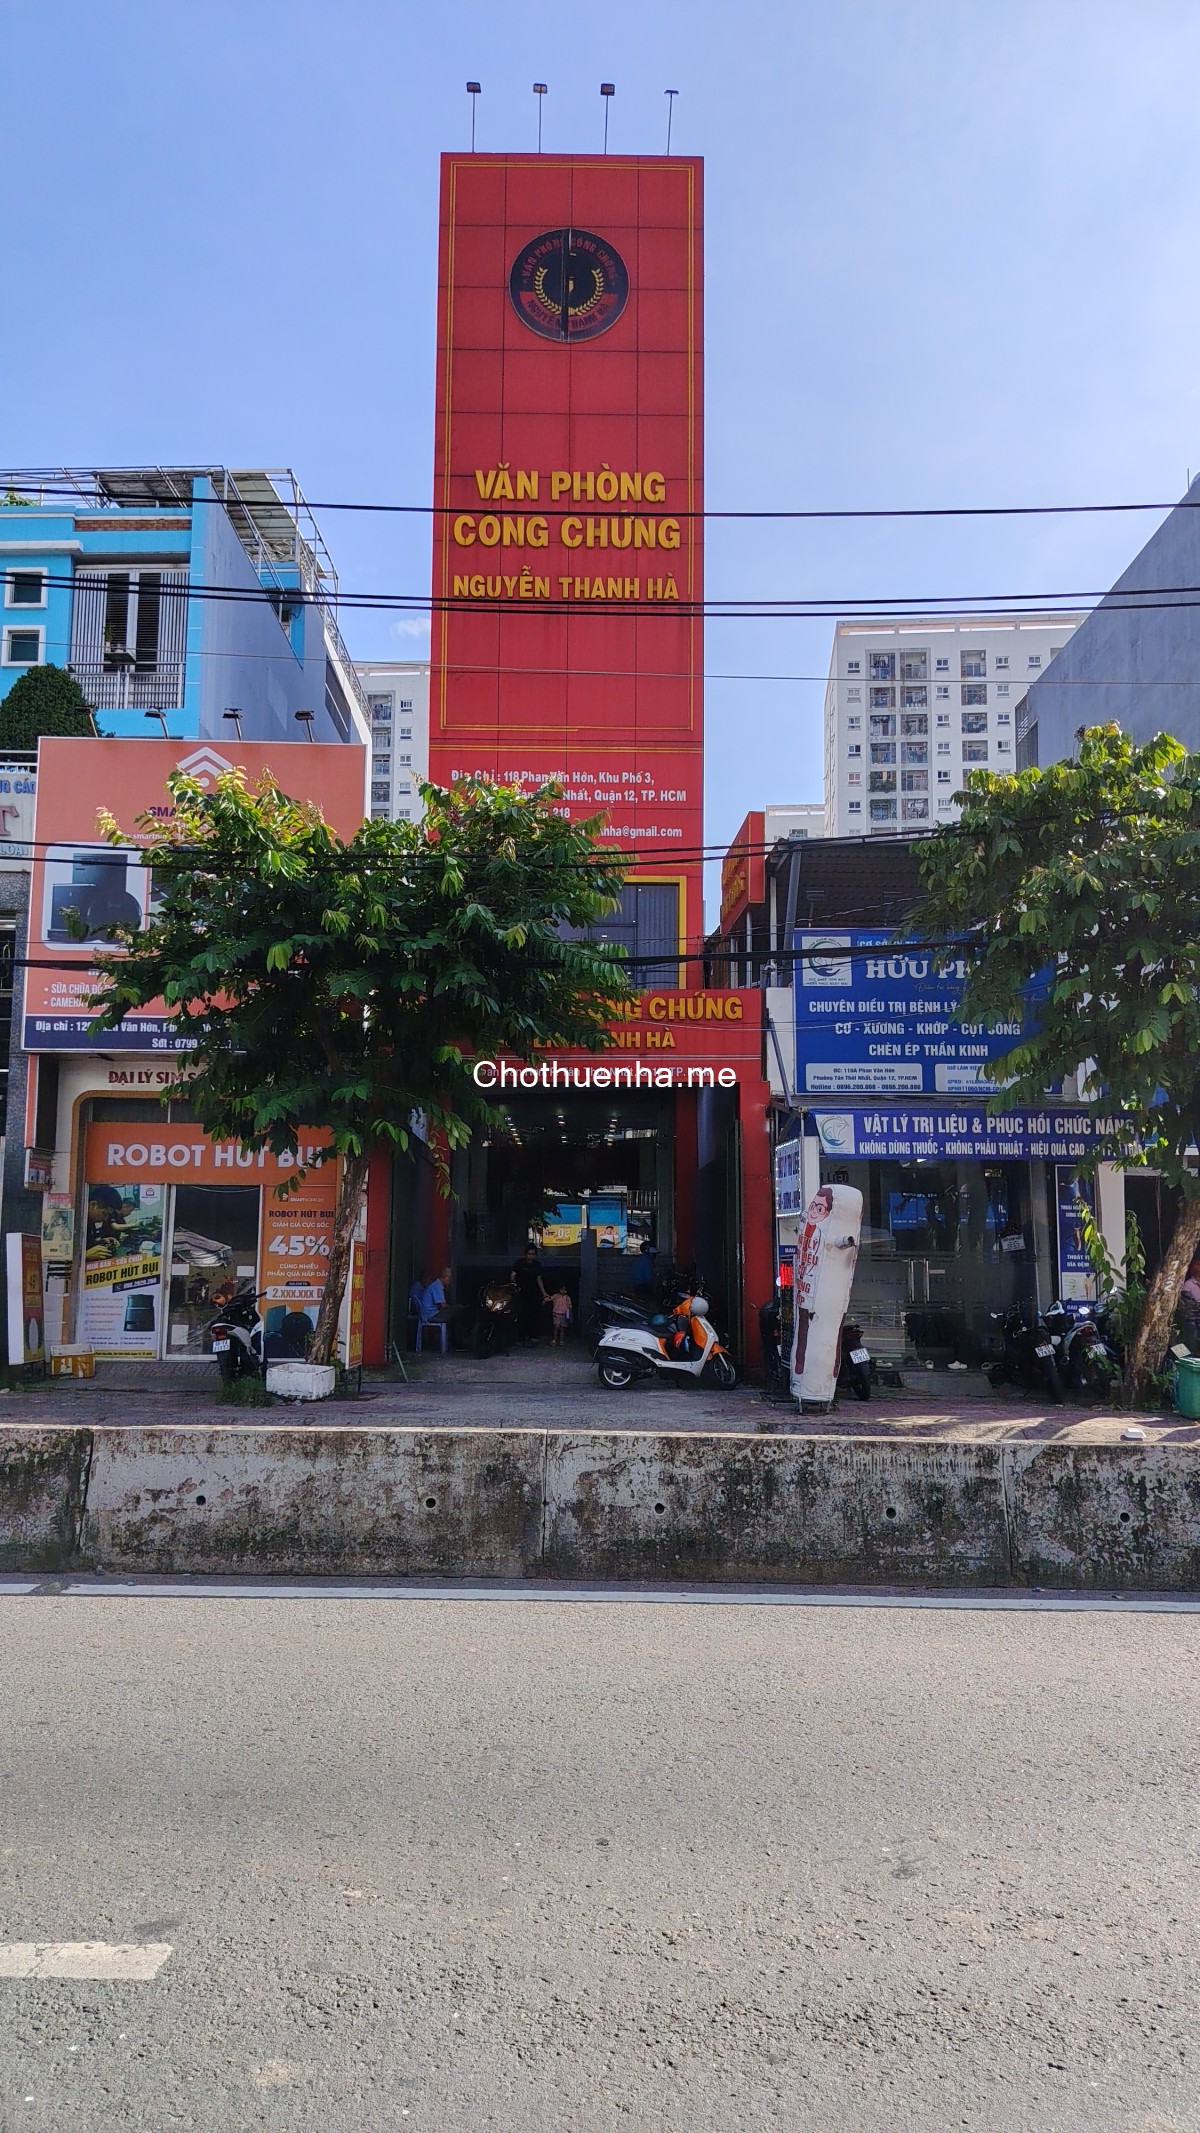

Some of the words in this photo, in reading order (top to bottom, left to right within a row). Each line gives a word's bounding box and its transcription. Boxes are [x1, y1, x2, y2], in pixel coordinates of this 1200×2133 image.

[475, 462, 539, 499] VĂN
[551, 464, 666, 502] PHÒNG
[453, 512, 549, 547] CÔNG
[560, 510, 681, 548] CHỨNG
[453, 565, 550, 598] NGUYỄN
[558, 576, 640, 599] THANH
[647, 573, 680, 600] HÀ
[503, 771, 519, 781] 118
[521, 771, 548, 782] Phan
[599, 772, 619, 783] Khu
[622, 771, 642, 783] Phố
[645, 772, 655, 786] 3,
[563, 788, 592, 803] Nhất,
[594, 789, 622, 803] Quận
[624, 790, 638, 803] 12,
[641, 790, 657, 801] TP.
[661, 790, 687, 801] HCM
[866, 955, 929, 979] HỮU
[649, 992, 743, 1020] CHỨNG
[809, 999, 855, 1013] CHUYÊN
[888, 1001, 906, 1015] TRỊ
[909, 999, 941, 1014] BỆNH
[36, 1021, 51, 1033] Địa
[54, 1020, 68, 1032] chỉ
[121, 1021, 138, 1032] Văn
[140, 1021, 161, 1034] Hớn,
[863, 1022, 905, 1035] XƯƠNG
[916, 1021, 949, 1035] KHỚP
[152, 1037, 167, 1048] Sđt
[646, 1027, 676, 1048] HÀ
[869, 1042, 902, 1056] CHÈN
[904, 1042, 920, 1056] ÉP
[959, 1045, 989, 1057] KINH
[108, 1070, 135, 1085] ĐẠI
[138, 1069, 154, 1084] LÝ
[156, 1071, 184, 1084] SIM
[863, 1114, 889, 1136] VẬT
[893, 1114, 909, 1133] LÝ
[912, 1117, 934, 1136] TRỊ
[938, 1114, 968, 1136] LIỆU
[971, 1117, 983, 1134] &
[987, 1117, 1024, 1137] PHỤC
[1054, 1115, 1092, 1135] CHỨC
[107, 1143, 205, 1167] ROBOT
[859, 1140, 887, 1155] KHÔNG
[889, 1140, 911, 1155] DÙNG
[912, 1138, 939, 1155] THUỐC
[946, 1140, 972, 1155] KHÔNG
[975, 1138, 996, 1156] PHẪU
[998, 1140, 1024, 1158] THUẬT
[1031, 1140, 1049, 1158] HIỆU
[1051, 1139, 1067, 1156] QUẢ
[1069, 1143, 1085, 1156] CAO
[268, 1210, 298, 1218] ROBOT
[300, 1209, 318, 1218] HÚT
[290, 1220, 301, 1228] GIÁ
[268, 1235, 331, 1256] 45%
[86, 1269, 118, 1286] ROBOT
[120, 1264, 139, 1278] HÚT
[142, 1261, 159, 1276] BỤI
